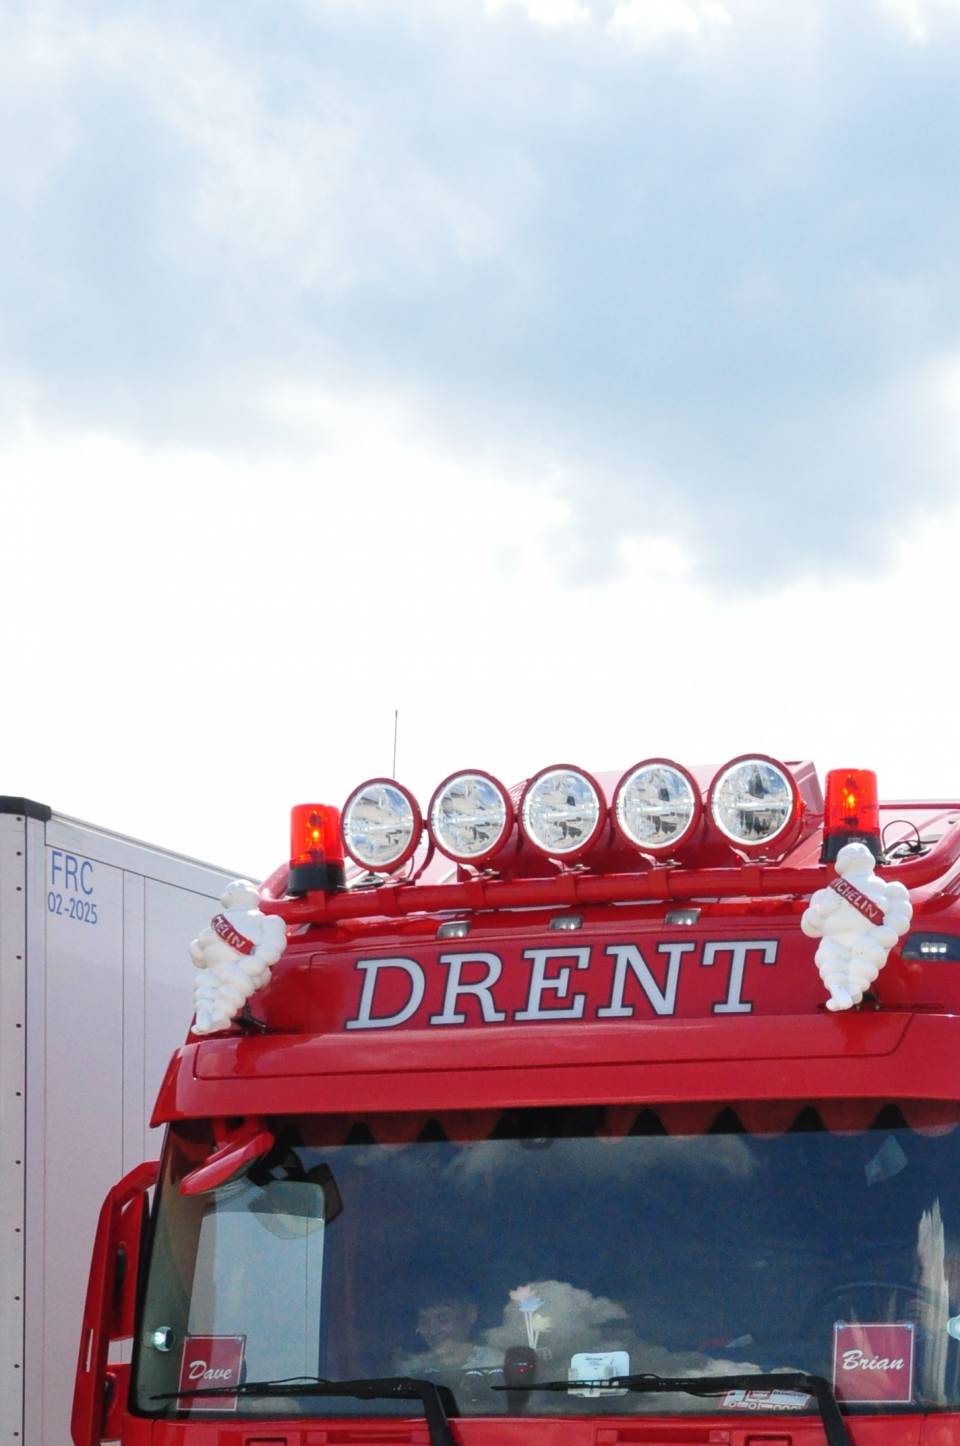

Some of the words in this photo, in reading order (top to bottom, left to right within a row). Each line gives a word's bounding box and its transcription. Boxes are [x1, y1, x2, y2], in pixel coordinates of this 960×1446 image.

[52, 850, 93, 895] FRC
[48, 891, 98, 925] 02-2025
[345, 938, 780, 1031] DRENT
[188, 1360, 233, 1380] Dave
[842, 1349, 905, 1370] Brian
